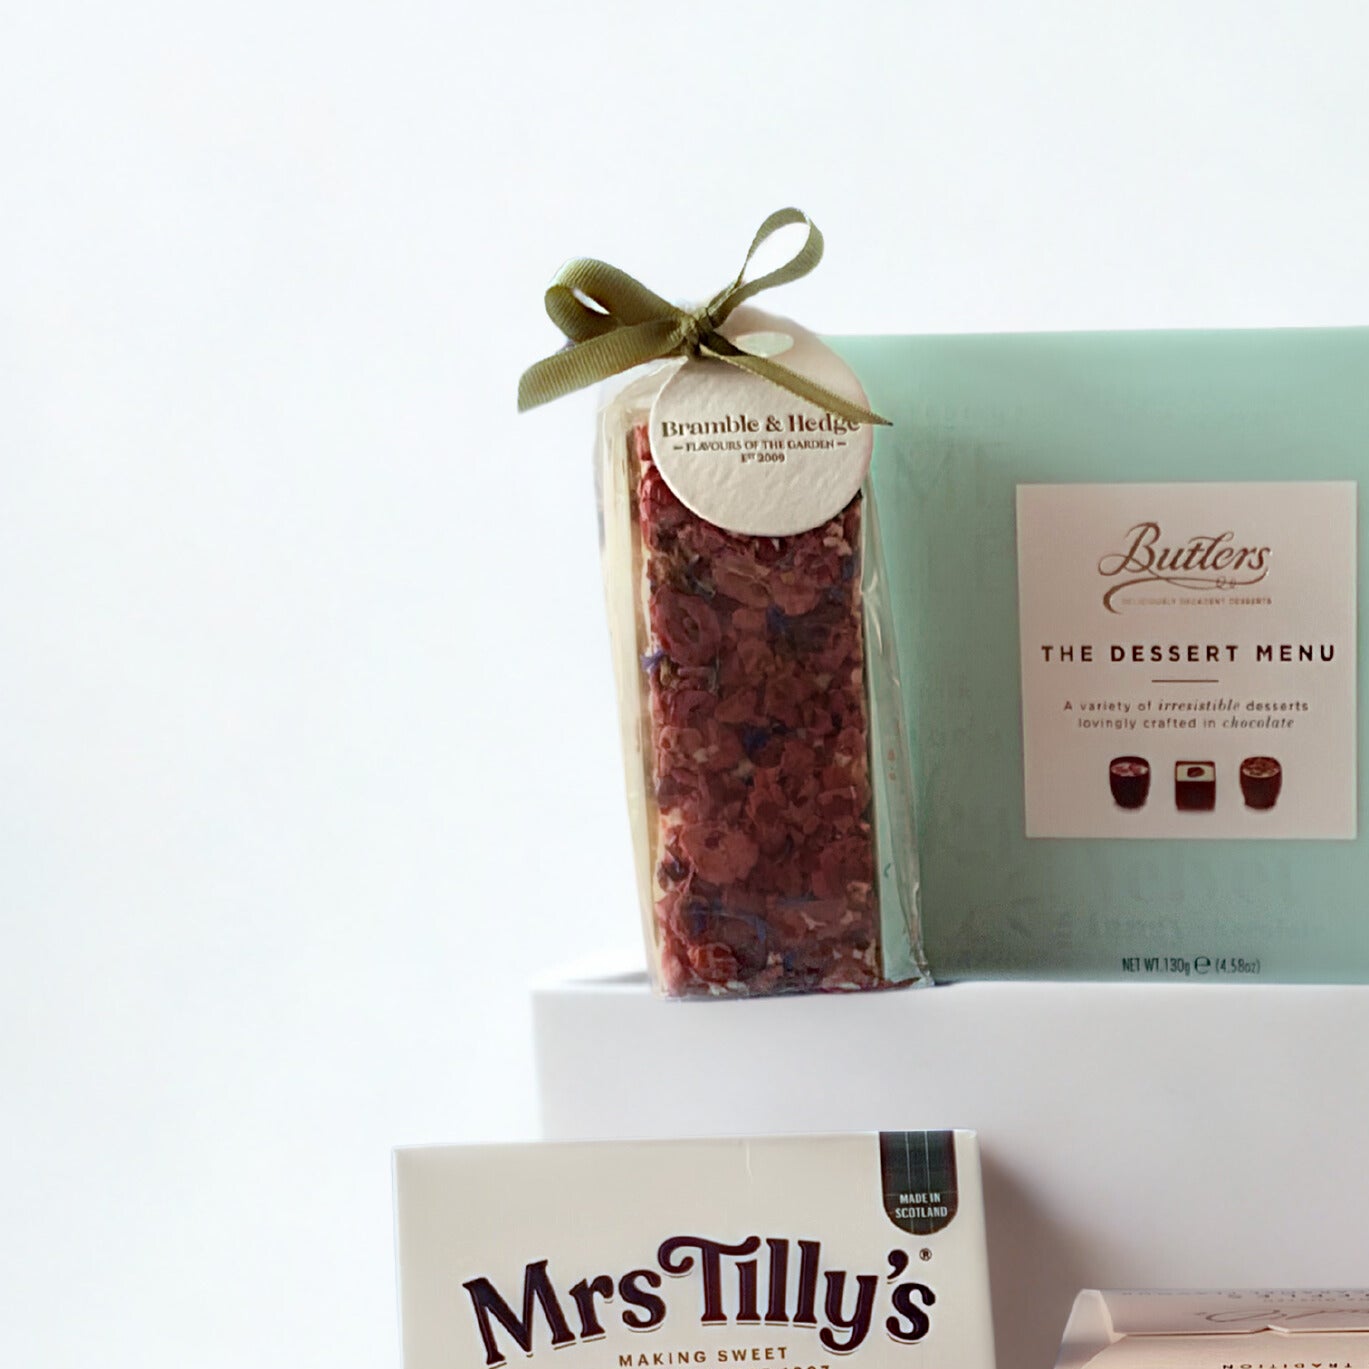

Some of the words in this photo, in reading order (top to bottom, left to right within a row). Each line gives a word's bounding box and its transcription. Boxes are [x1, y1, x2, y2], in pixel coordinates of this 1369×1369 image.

[662, 415, 759, 437] Bramble
[766, 415, 783, 432] &
[789, 413, 860, 435] Hedge
[686, 441, 741, 452] FLAVOURS
[744, 440, 758, 450] OF
[762, 440, 785, 450] THE
[788, 440, 834, 450] GARDEN
[758, 453, 785, 463] 2009
[1098, 521, 1272, 590] Butlers
[1041, 645, 1094, 663] THE
[1111, 645, 1239, 662] DESSERT
[1256, 645, 1336, 662] MENU
[1063, 701, 1073, 711] A
[1080, 700, 1131, 714] variety
[1138, 700, 1153, 712] of
[1158, 698, 1240, 712] irresistible
[1246, 700, 1309, 712] desserts
[1078, 717, 1136, 731] lovingly
[1143, 716, 1196, 729] crafted
[1203, 717, 1216, 729] in
[1222, 716, 1295, 729] chocolate
[1122, 957, 1140, 972] NET
[1215, 957, 1261, 974] (4.58oz)
[900, 1193, 928, 1204] MADE
[930, 1192, 941, 1203] IN
[895, 1206, 948, 1218] SCOTLAND
[462, 1259, 668, 1369] Mrs
[657, 1235, 936, 1354] Tilly's
[619, 1350, 706, 1368] MAKING
[717, 1346, 788, 1363] SWEET
[1222, 1362, 1353, 1369] TRADITION
